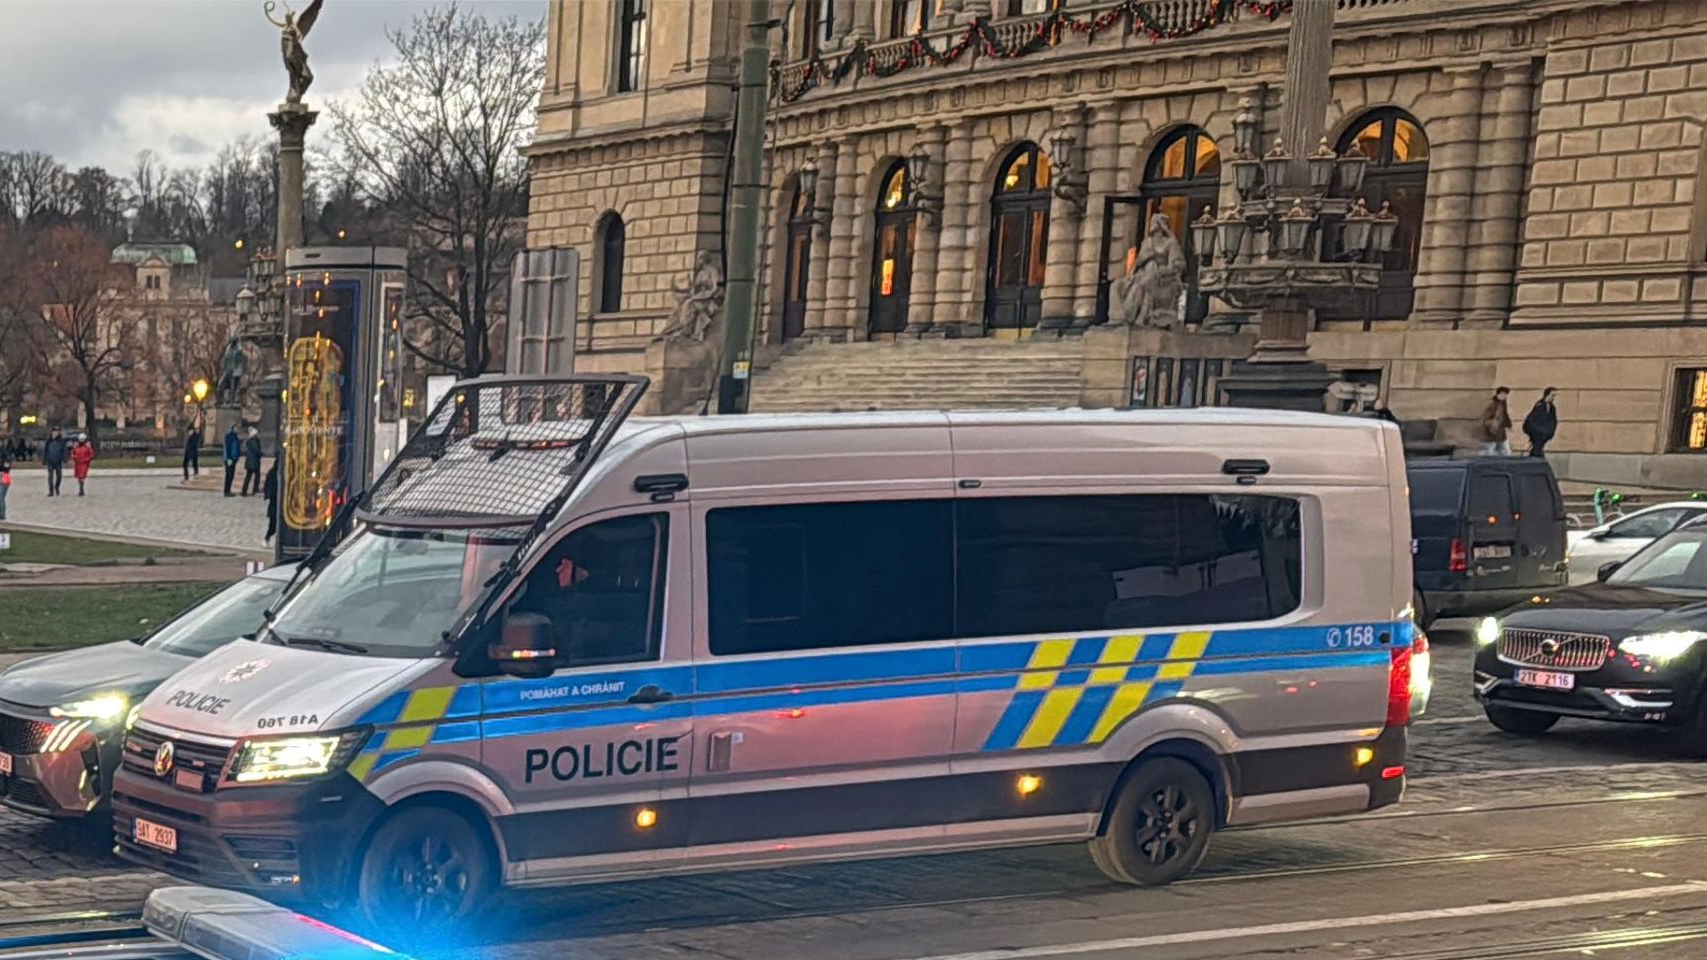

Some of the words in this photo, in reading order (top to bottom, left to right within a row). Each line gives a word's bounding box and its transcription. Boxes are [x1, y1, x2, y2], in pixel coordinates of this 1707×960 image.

[1345, 625, 1374, 647] 158
[520, 685, 569, 700] POMÁHAT
[571, 685, 580, 696] A
[581, 680, 626, 696] CHRÁNIT
[165, 690, 231, 715] POLICIE
[525, 736, 679, 785] POLICIE
